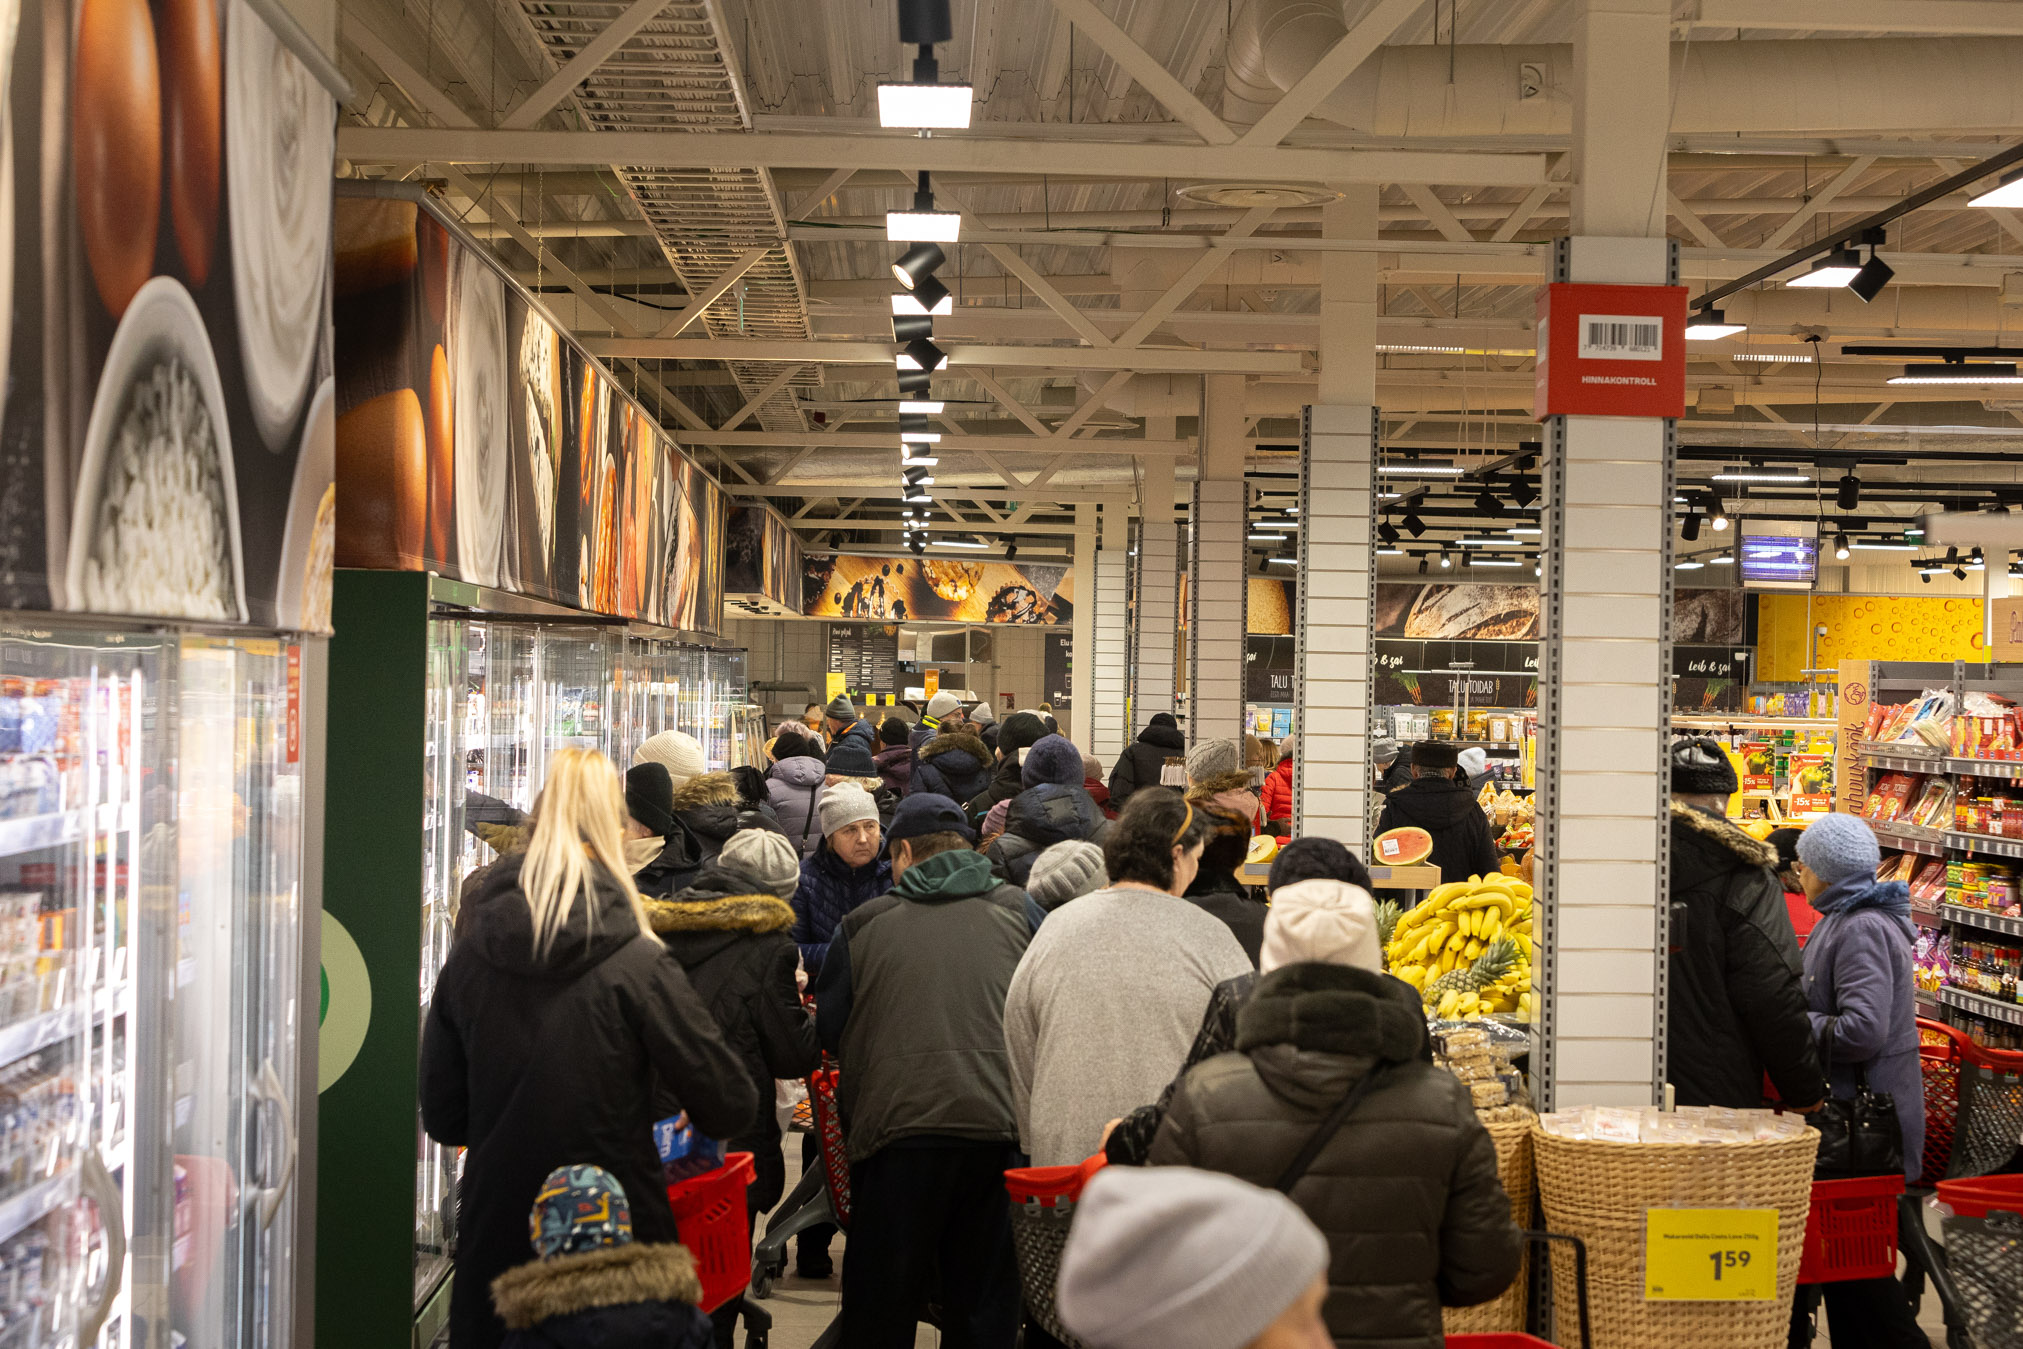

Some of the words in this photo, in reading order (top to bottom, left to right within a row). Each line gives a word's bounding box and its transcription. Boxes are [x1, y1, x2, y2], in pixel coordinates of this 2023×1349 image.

[1581, 376, 1657, 386] HINNAKONTROLL
[1688, 659, 1707, 673] Leib
[1708, 661, 1717, 672] &
[1270, 674, 1288, 689] TALU
[1468, 680, 1494, 694] TOIDAB
[1843, 721, 1865, 815] ahvusköök
